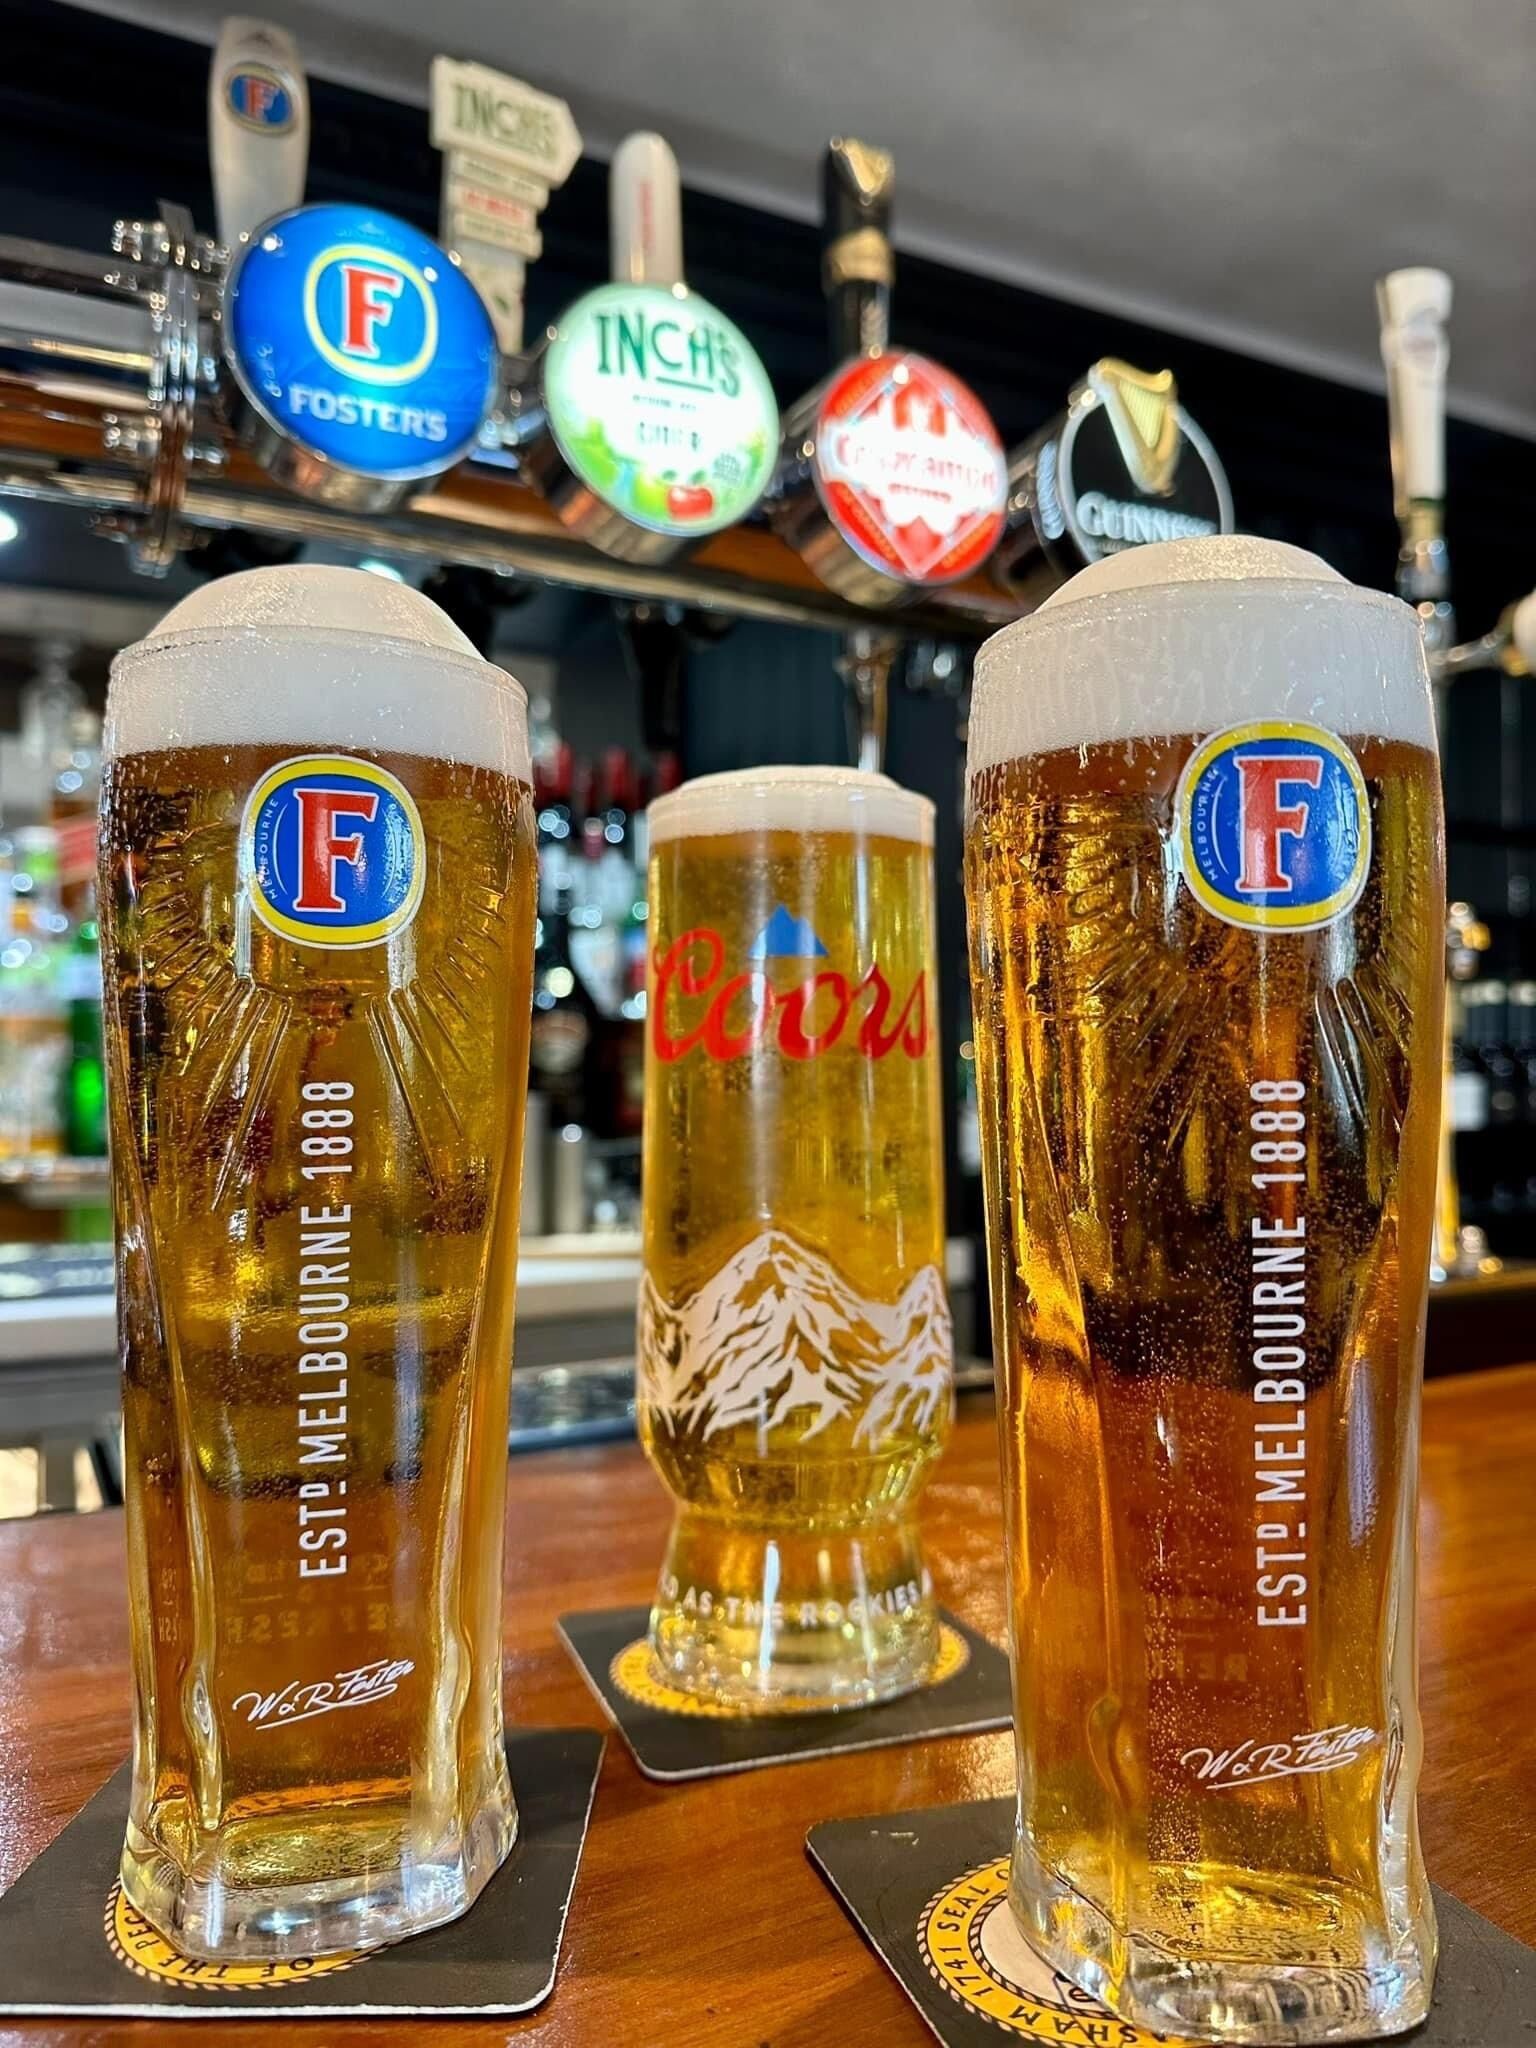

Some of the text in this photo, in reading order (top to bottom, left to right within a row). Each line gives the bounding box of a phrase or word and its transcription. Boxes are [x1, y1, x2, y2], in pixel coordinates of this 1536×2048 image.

[340, 264, 404, 358] F
[593, 308, 741, 398] INCH'S
[288, 383, 448, 442] FOSTER'S
[293, 787, 379, 912] F
[1232, 755, 1324, 892] F
[653, 926, 930, 1064] Coors
[300, 1081, 354, 1179] 1888
[1250, 1079, 1307, 1190] 1888
[299, 1204, 352, 1464] MELBOURNE
[1252, 1216, 1307, 1502] MELBOURNE
[683, 1586, 713, 1614] AS
[937, 1885, 991, 1933] SEAL
[158, 1953, 231, 1979] THE
[260, 1956, 315, 1979] OF
[939, 1946, 995, 1997] 1741
